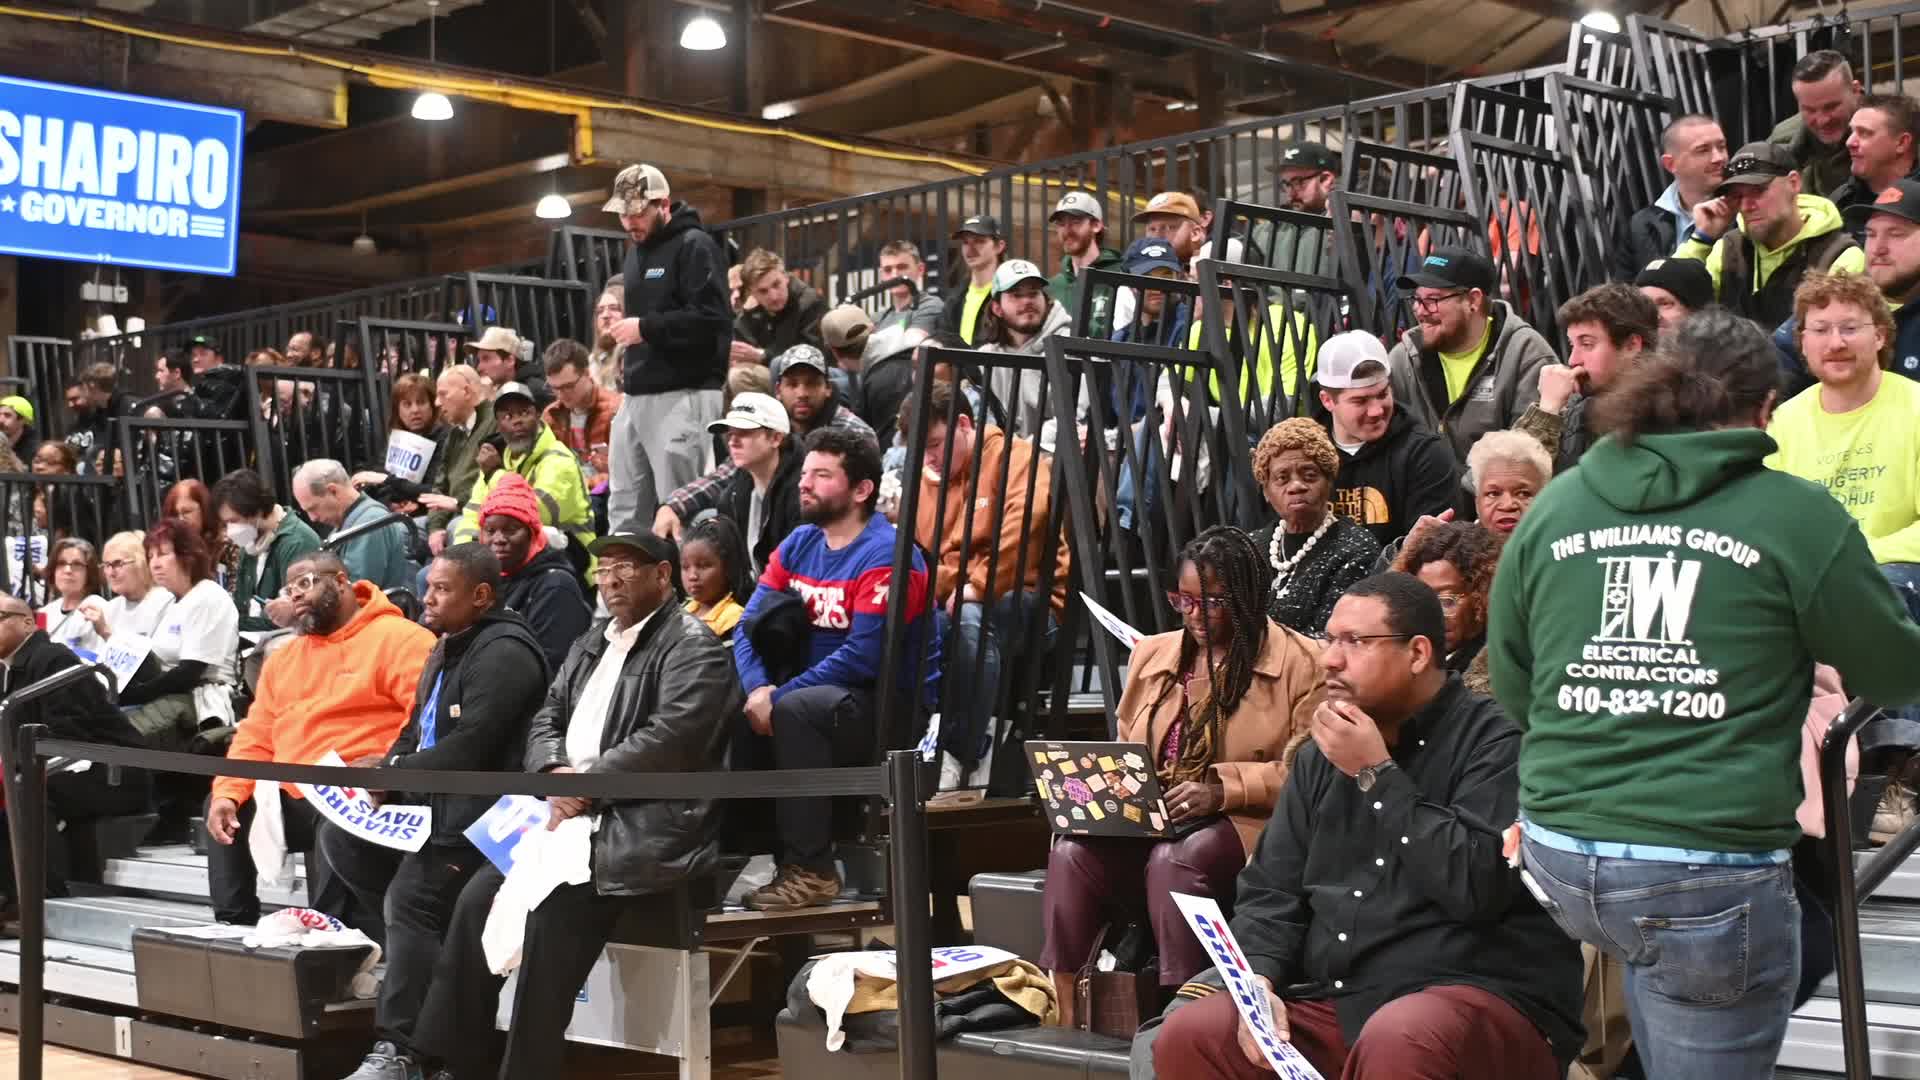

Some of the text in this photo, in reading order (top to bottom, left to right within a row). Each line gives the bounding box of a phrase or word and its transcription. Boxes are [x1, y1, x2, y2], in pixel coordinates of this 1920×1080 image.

[0, 110, 229, 209] SHAPIRO
[20, 191, 189, 238] GOVERNOR
[1551, 525, 1760, 568] THE WILLIAMS GROUP
[1565, 662, 1719, 685] CONTRACTORS
[1582, 644, 1700, 664] ELECTRICAL
[1557, 684, 1726, 720] 610-832-1200
[313, 784, 418, 840] SHAPIRO
